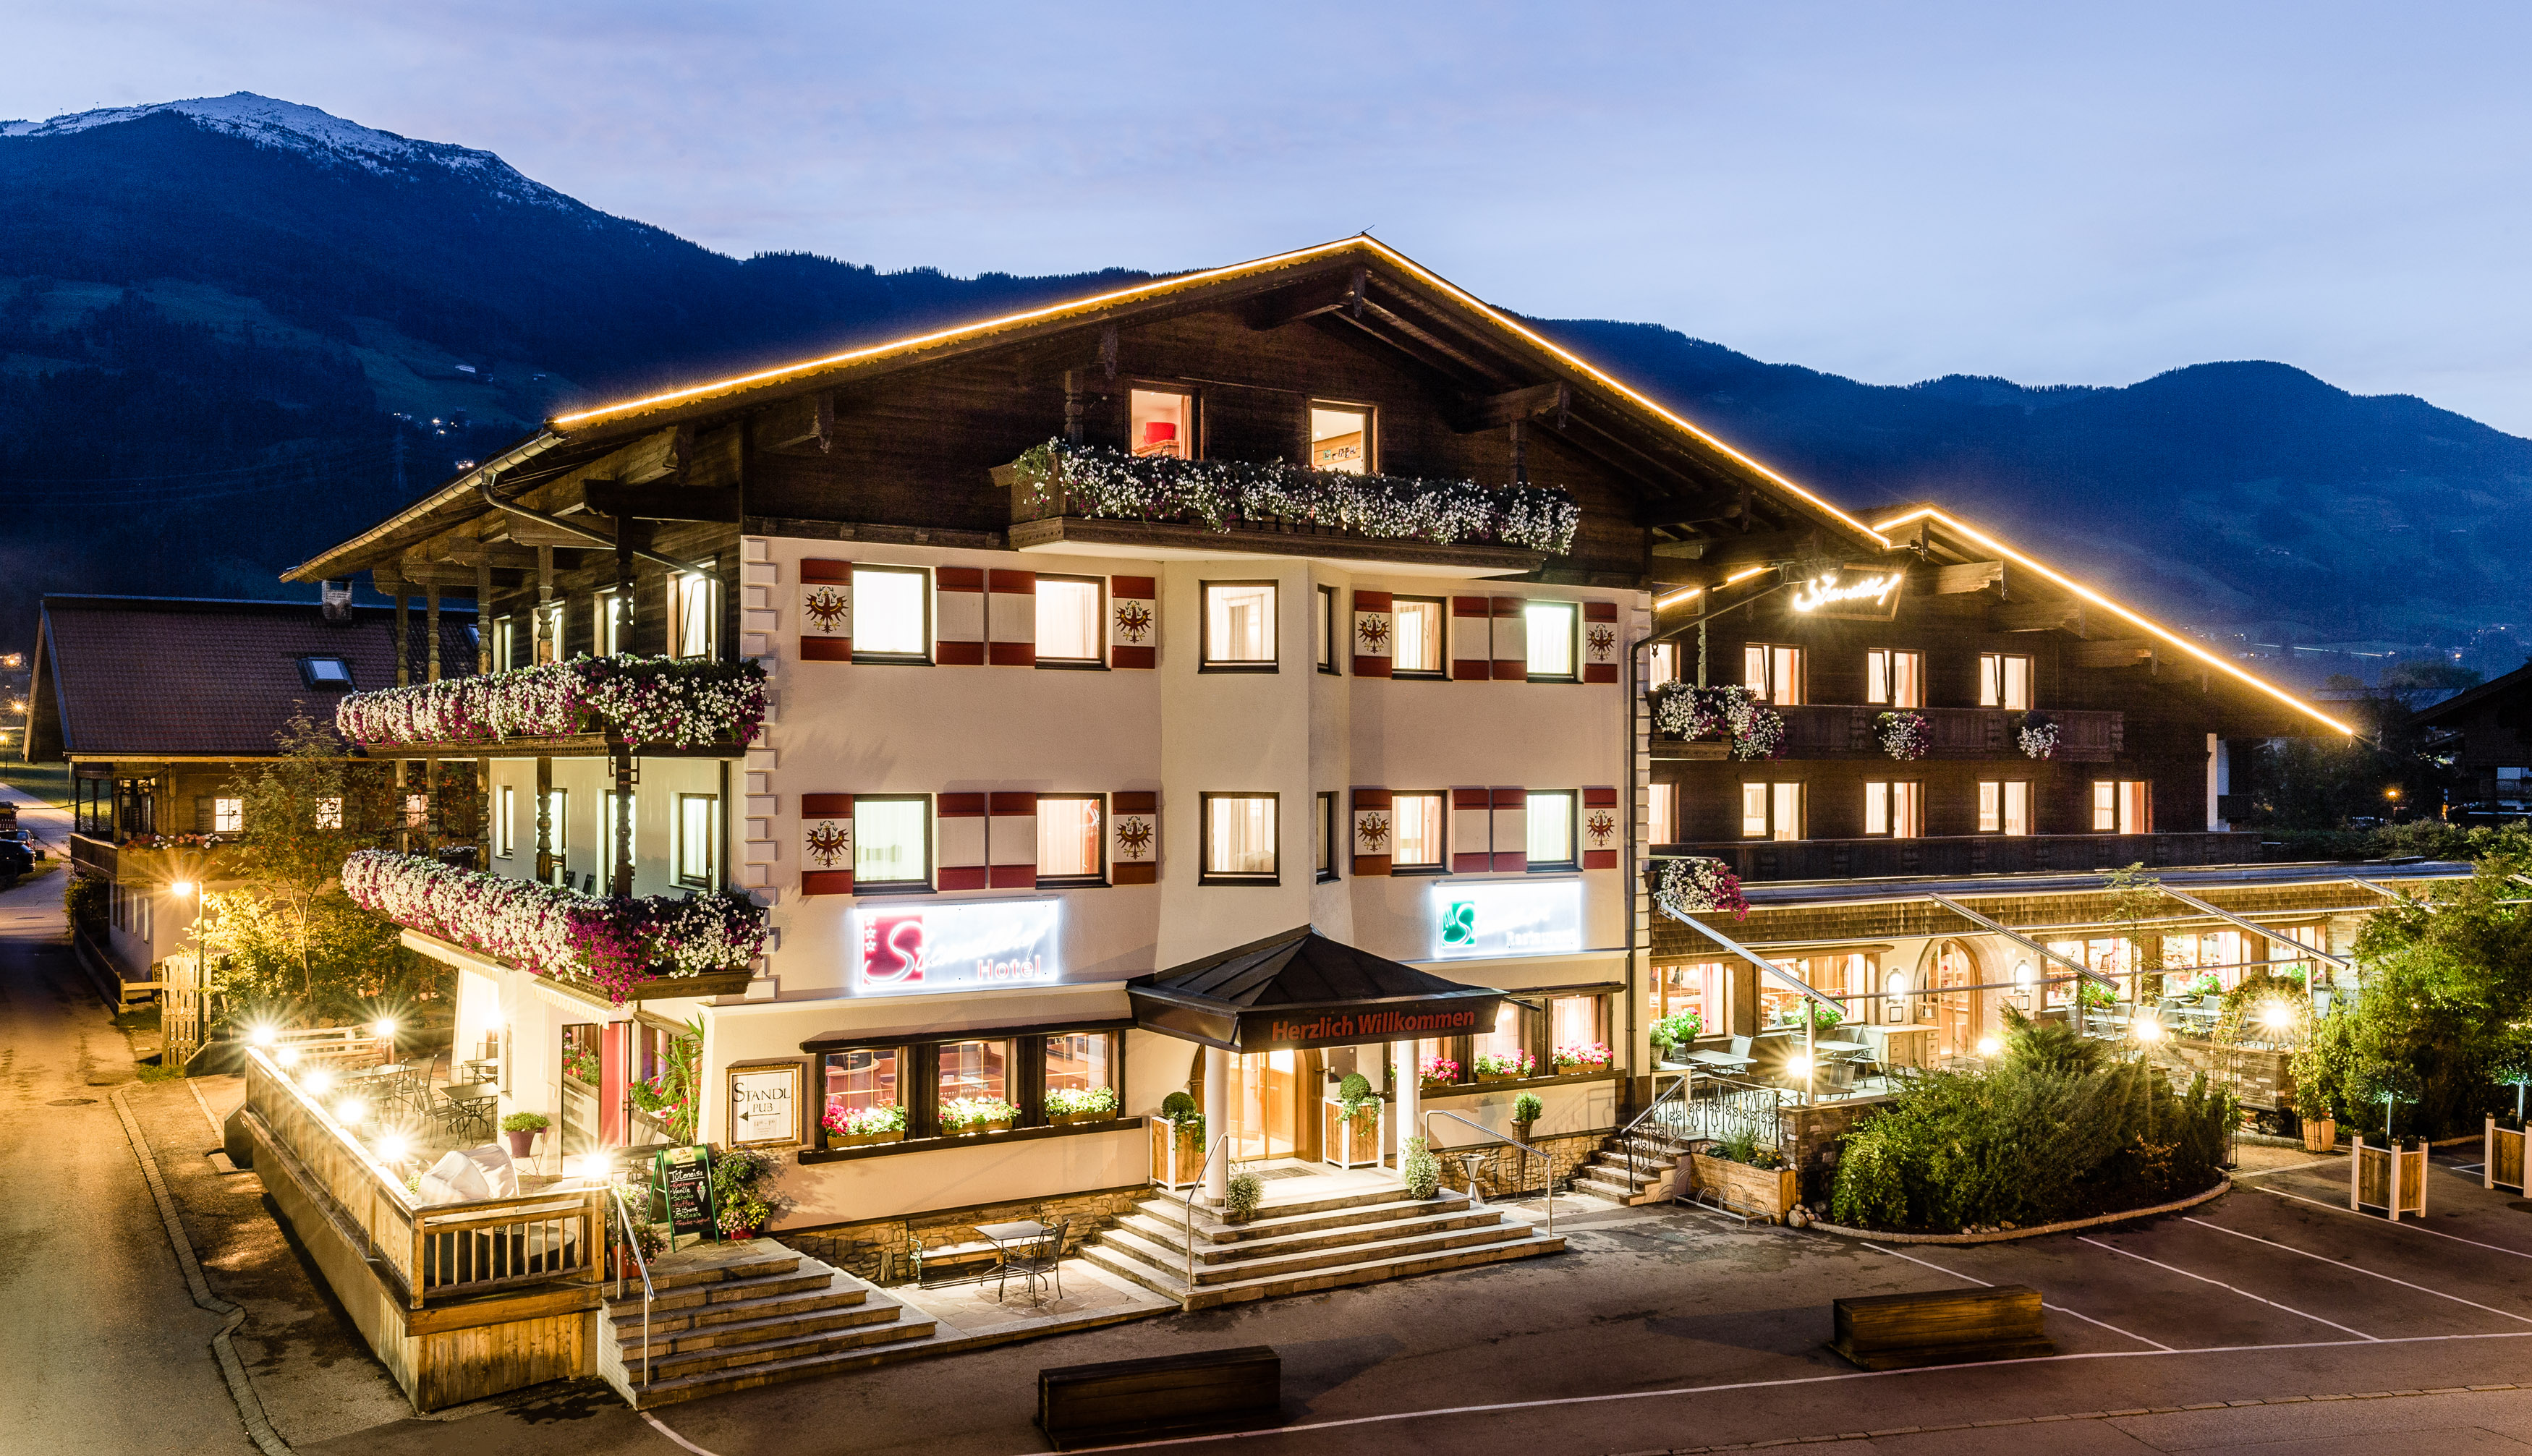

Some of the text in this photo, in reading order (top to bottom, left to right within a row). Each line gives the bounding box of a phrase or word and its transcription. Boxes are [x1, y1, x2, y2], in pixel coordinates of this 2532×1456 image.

[977, 955, 1040, 979] Hotel
[1272, 1011, 1474, 1042] Herzlich Willkommen
[733, 1082, 790, 1102] STANDL
[753, 1102, 773, 1112] PUB
